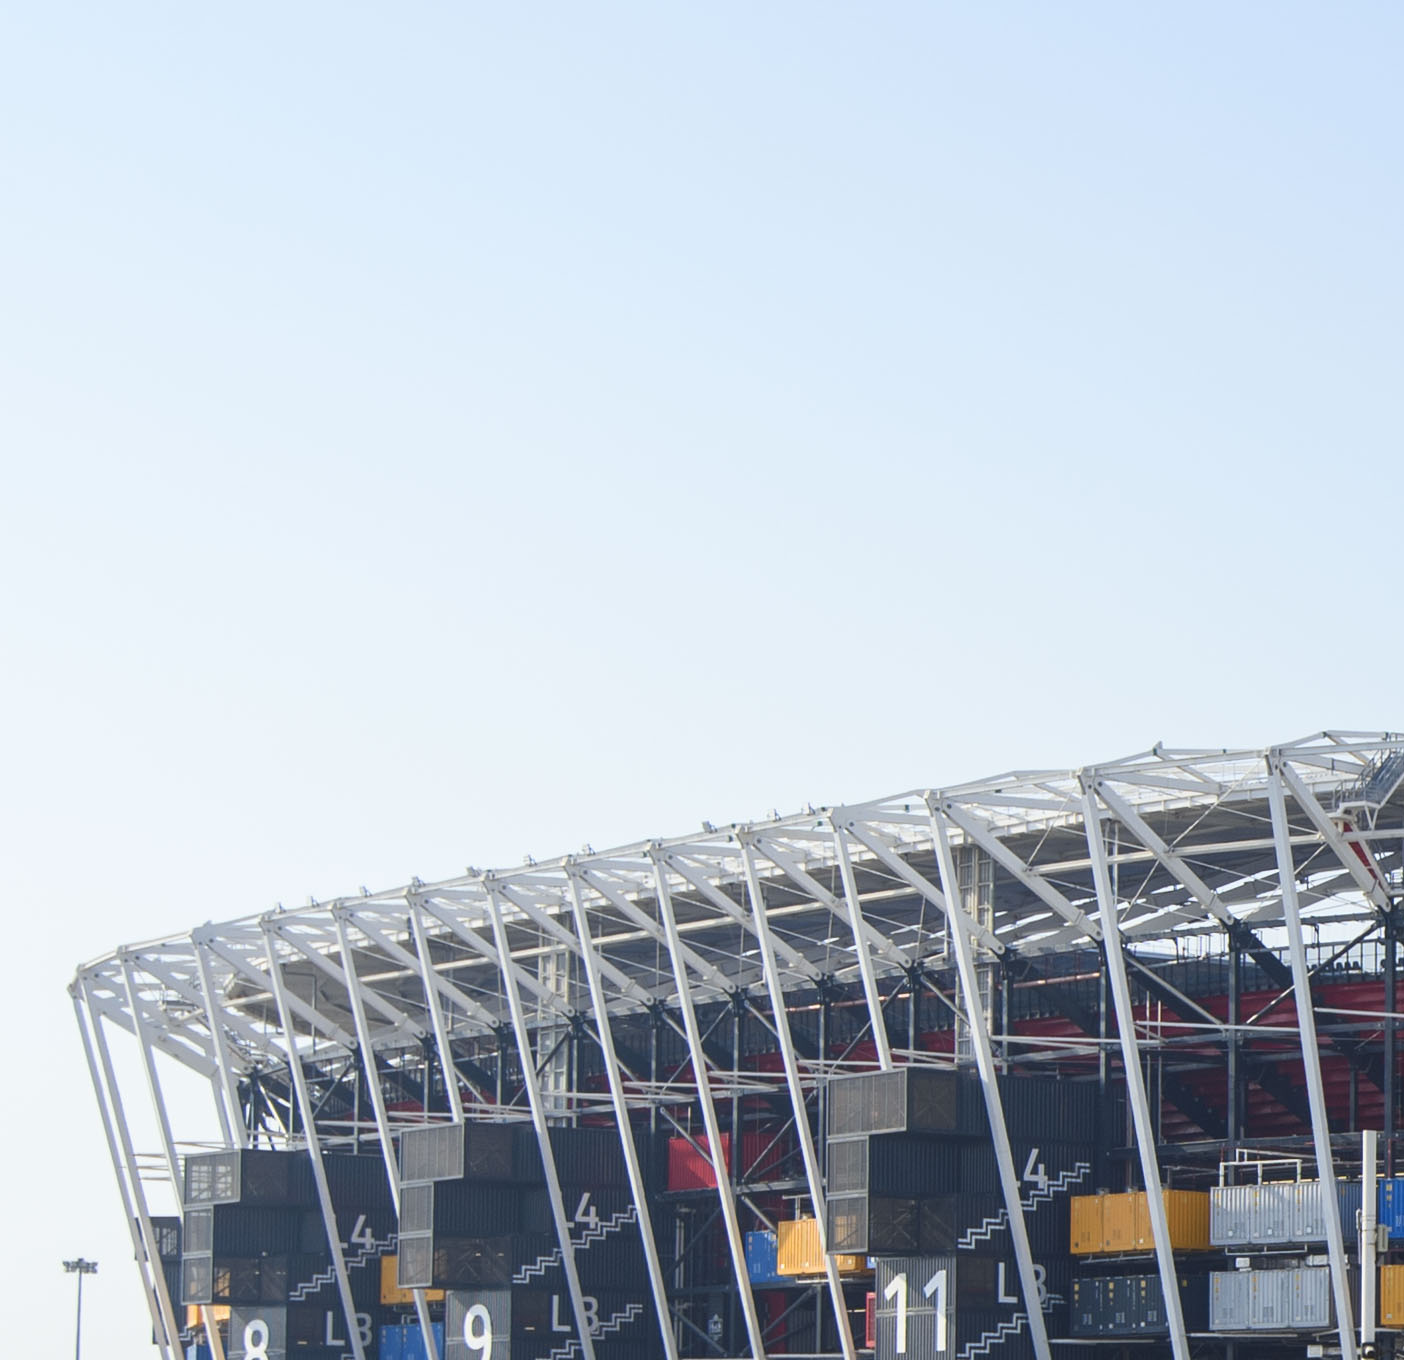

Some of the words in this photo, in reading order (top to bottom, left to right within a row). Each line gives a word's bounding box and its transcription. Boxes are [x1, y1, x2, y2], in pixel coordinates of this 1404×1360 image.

[1016, 1148, 1048, 1189] 4
[565, 1192, 599, 1229] 4
[340, 1215, 376, 1249] 4
[884, 1269, 948, 1354] 11
